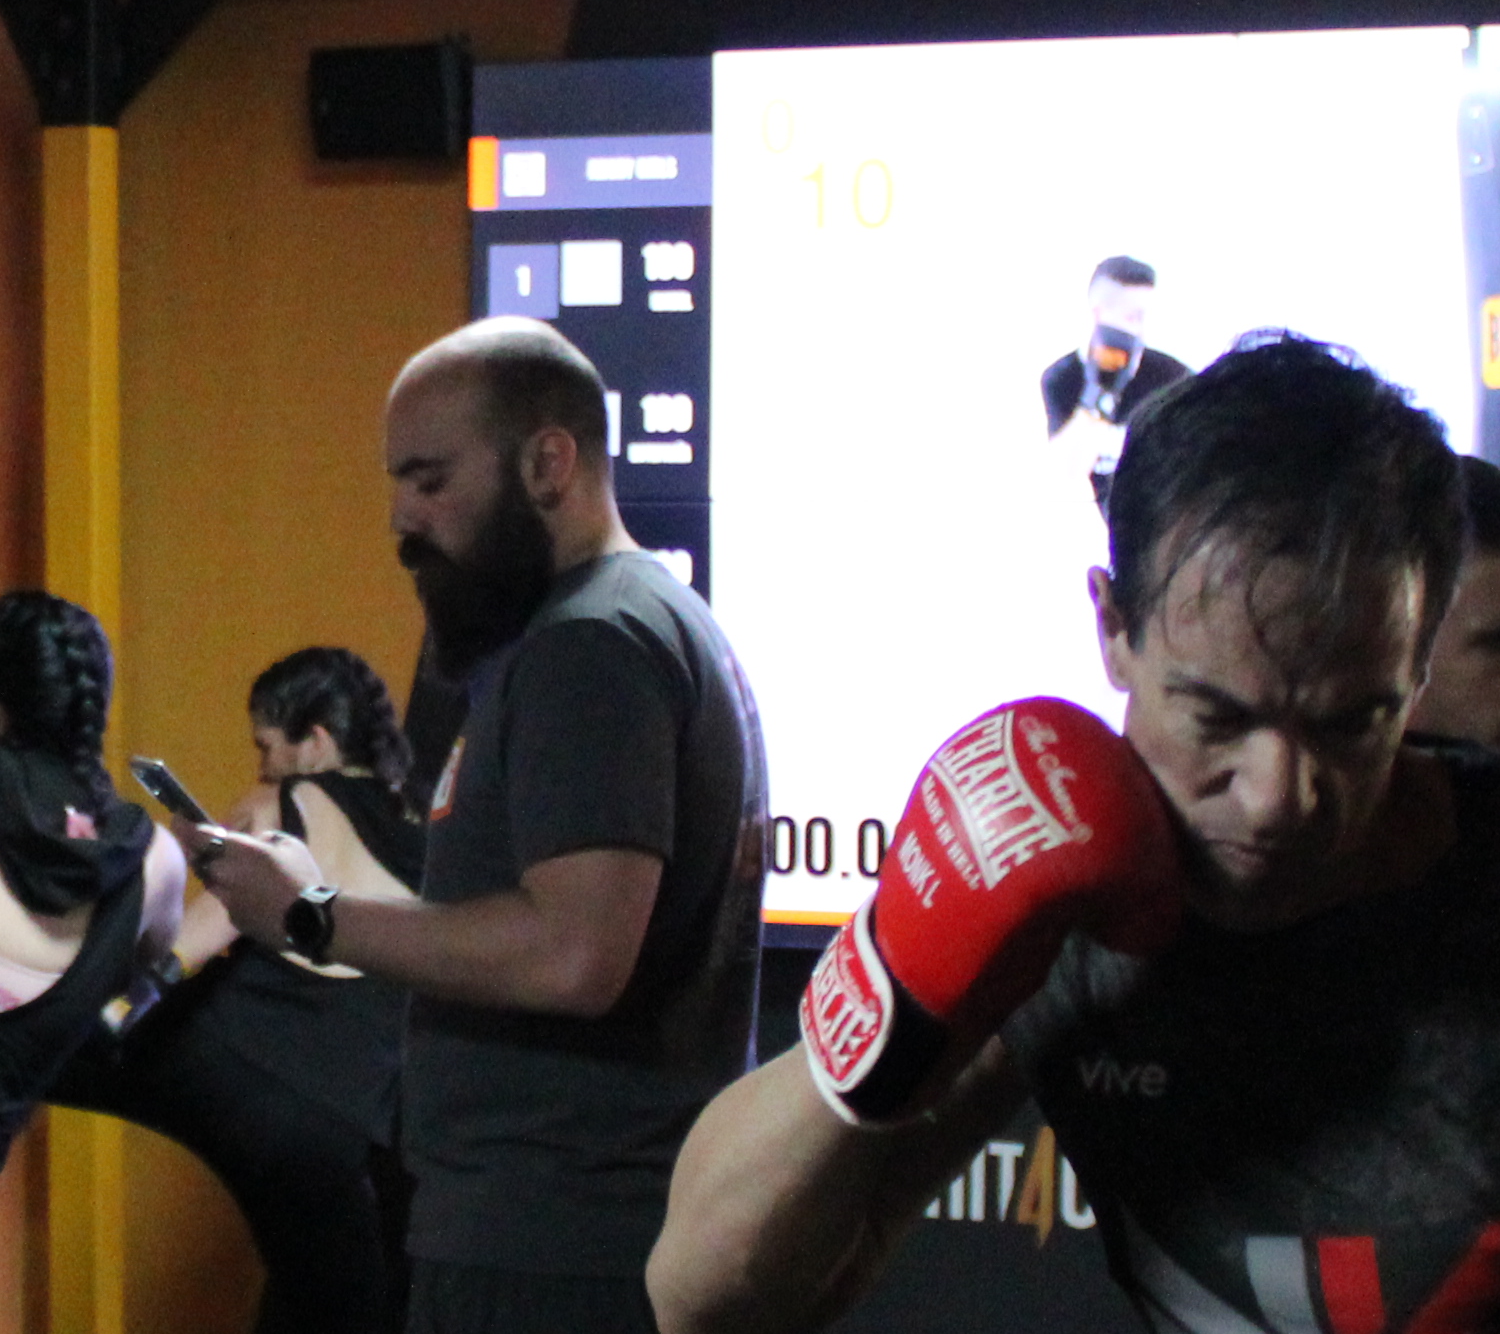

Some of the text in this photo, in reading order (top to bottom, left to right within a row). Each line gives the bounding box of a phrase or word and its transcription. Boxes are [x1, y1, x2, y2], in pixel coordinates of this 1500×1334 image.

[803, 157, 896, 231] 10
[937, 713, 1058, 885] CHARLIE
[1077, 1056, 1168, 1098] vive
